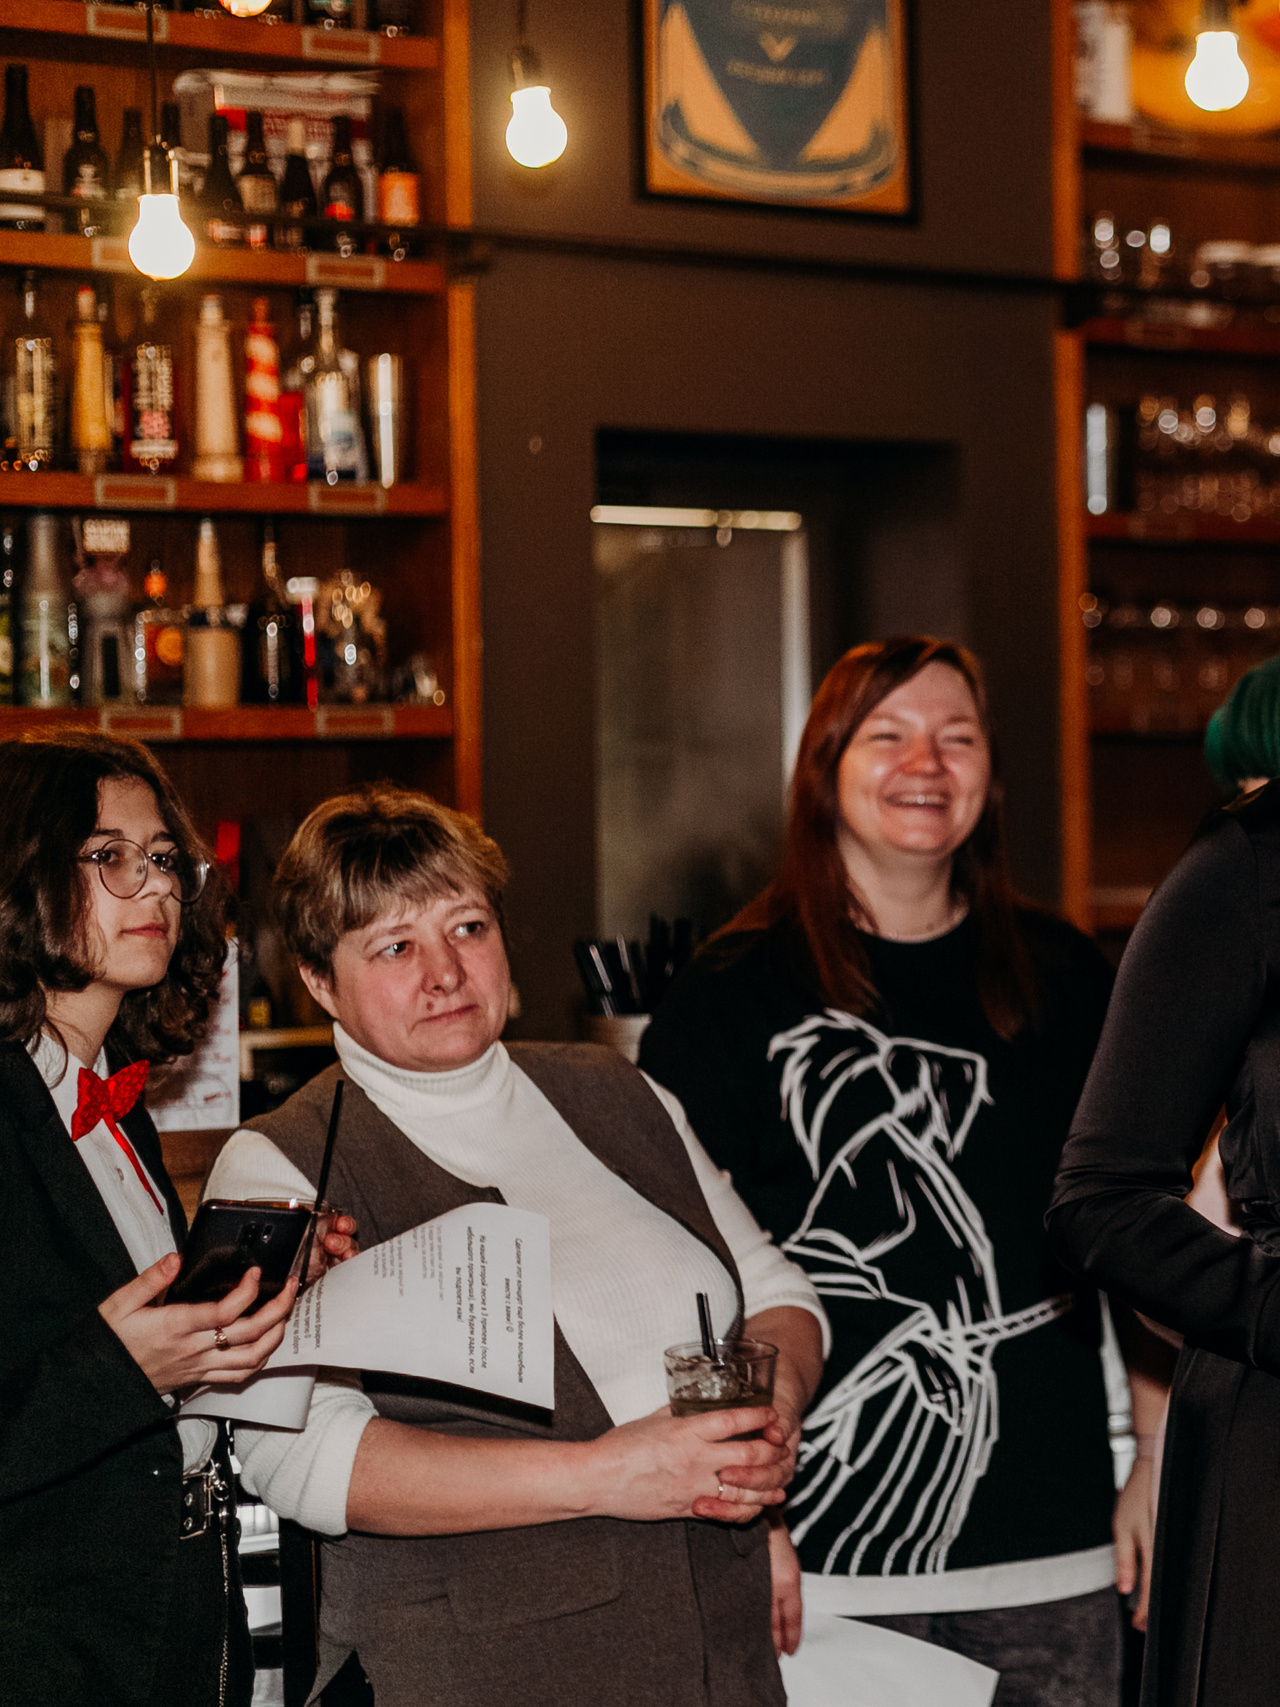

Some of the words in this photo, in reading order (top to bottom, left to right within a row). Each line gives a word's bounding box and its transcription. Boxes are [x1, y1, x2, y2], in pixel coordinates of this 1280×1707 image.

[515, 1238, 523, 1264] Сделаем
[480, 1265, 488, 1286] второй
[505, 1306, 513, 1325] вами!
[480, 1346, 489, 1368] (после
